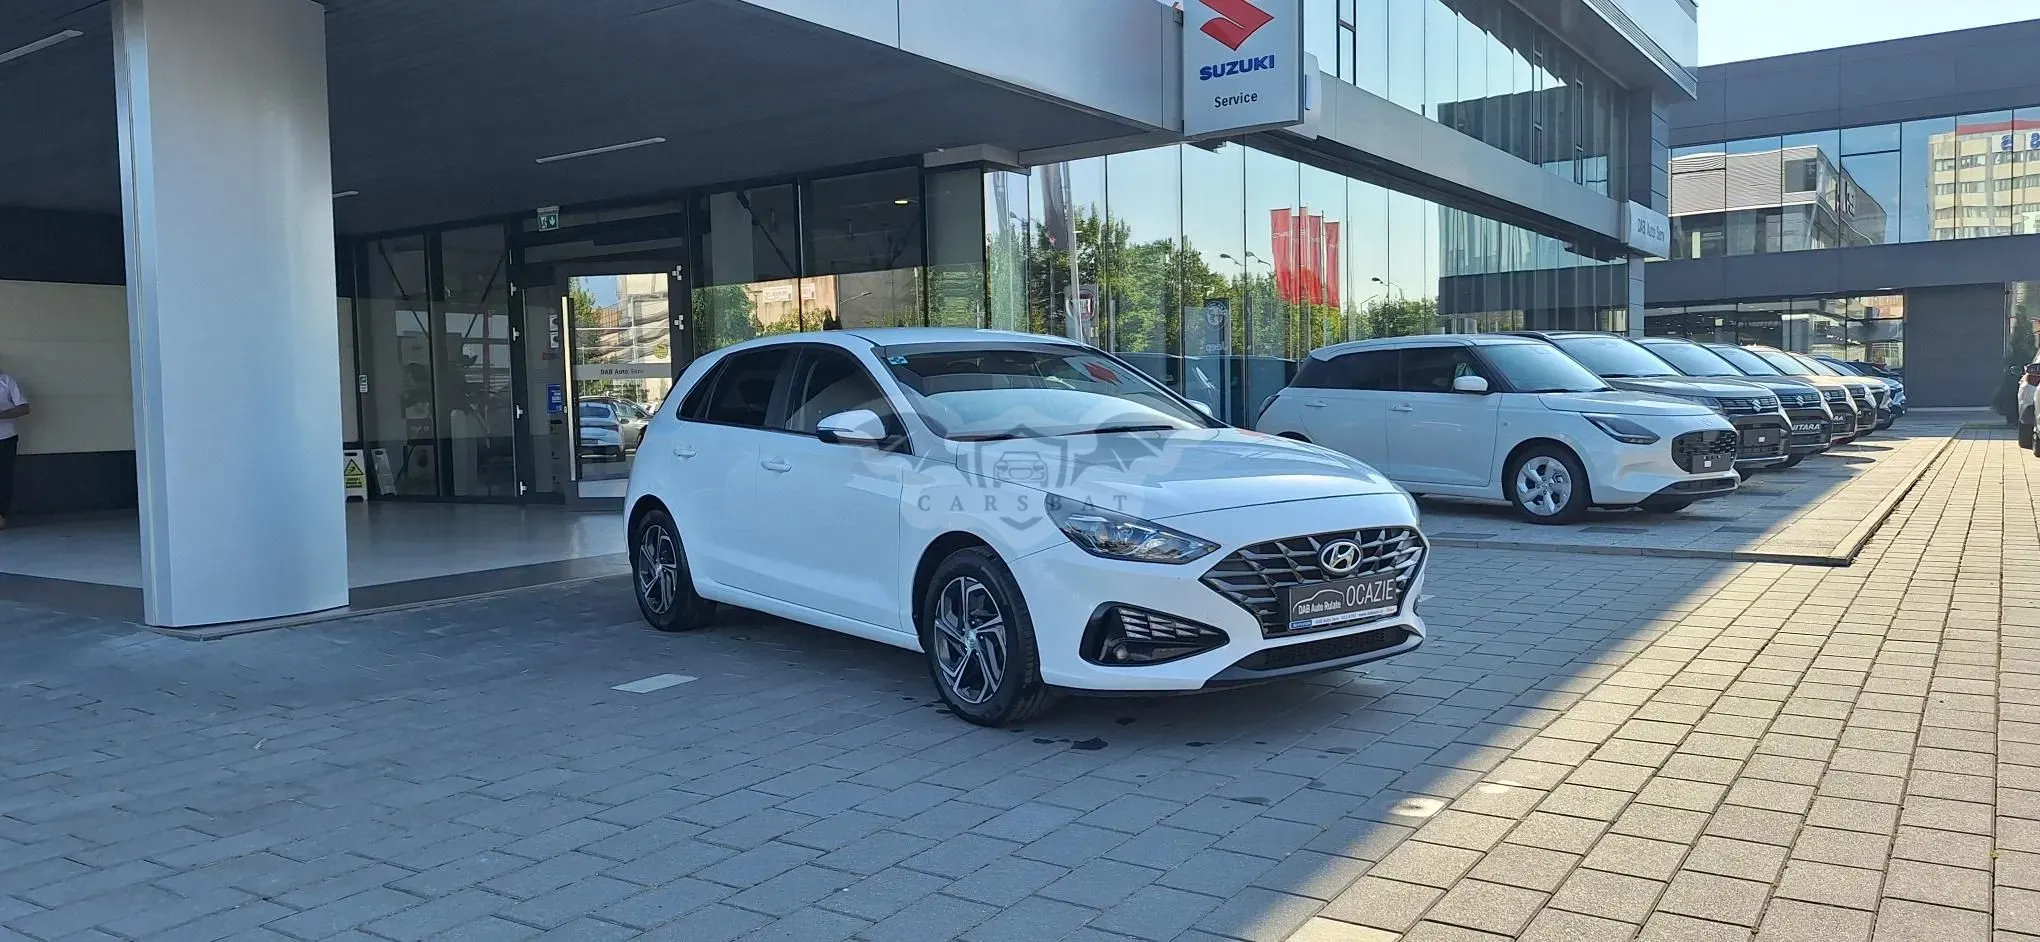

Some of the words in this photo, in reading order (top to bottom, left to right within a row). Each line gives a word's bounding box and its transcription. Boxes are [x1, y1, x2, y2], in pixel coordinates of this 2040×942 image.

[1199, 54, 1275, 81] SUZUKI
[1214, 91, 1258, 108] Service
[1636, 217, 1646, 234] DAB
[1646, 221, 1656, 239] Auto
[1656, 224, 1665, 242] Serv
[1345, 578, 1395, 607] OCAZIE
[1298, 604, 1310, 615] DAB
[1311, 603, 1323, 612] Auto
[1324, 600, 1341, 611] Rulate
